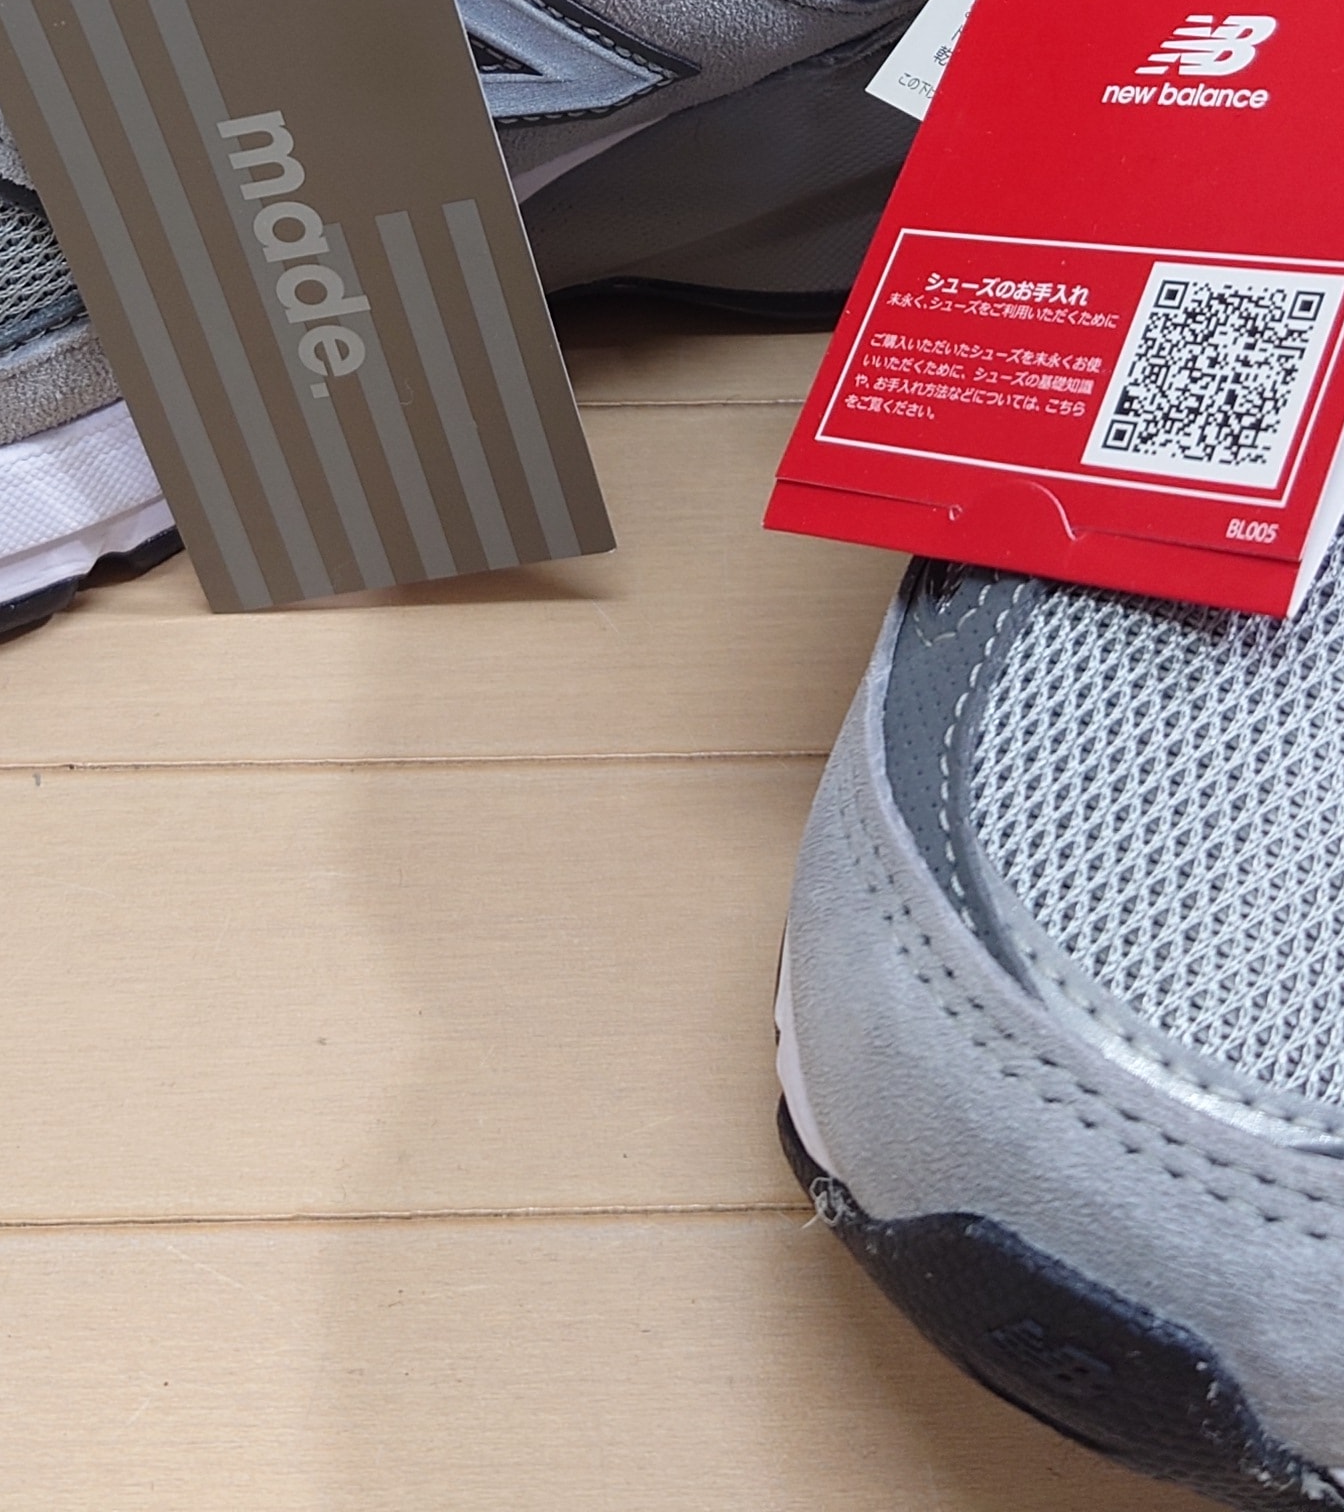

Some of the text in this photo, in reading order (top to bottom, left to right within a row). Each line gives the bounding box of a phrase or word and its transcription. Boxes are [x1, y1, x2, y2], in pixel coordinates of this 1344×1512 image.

[1101, 82, 1270, 109] new balance
[924, 272, 1090, 307] シューズのお手入れ
[1226, 518, 1278, 544] BL005
